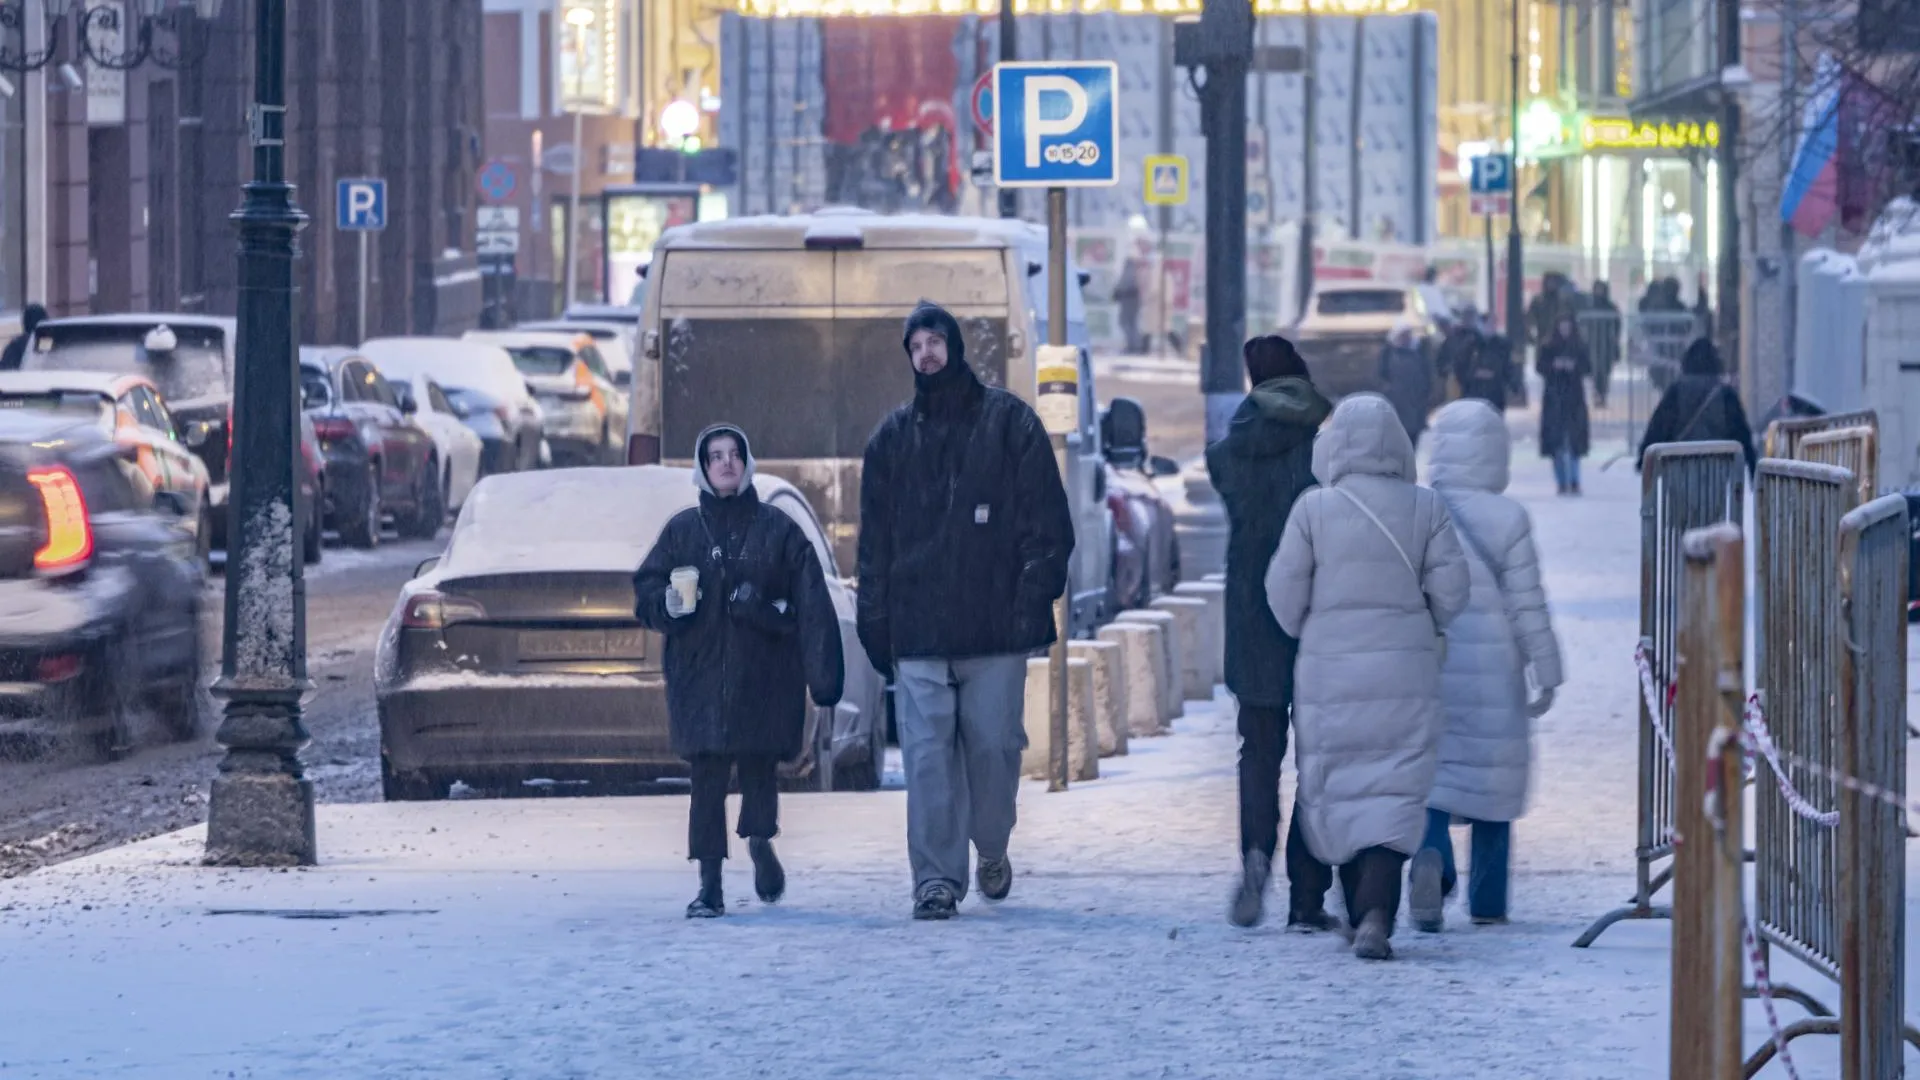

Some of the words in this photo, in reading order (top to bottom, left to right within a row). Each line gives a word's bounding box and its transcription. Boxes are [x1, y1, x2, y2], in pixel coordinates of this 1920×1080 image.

[1024, 75, 1088, 168] P
[1061, 147, 1074, 159] 15
[1079, 146, 1097, 160] 20
[1479, 157, 1504, 189] P
[349, 185, 376, 224] P
